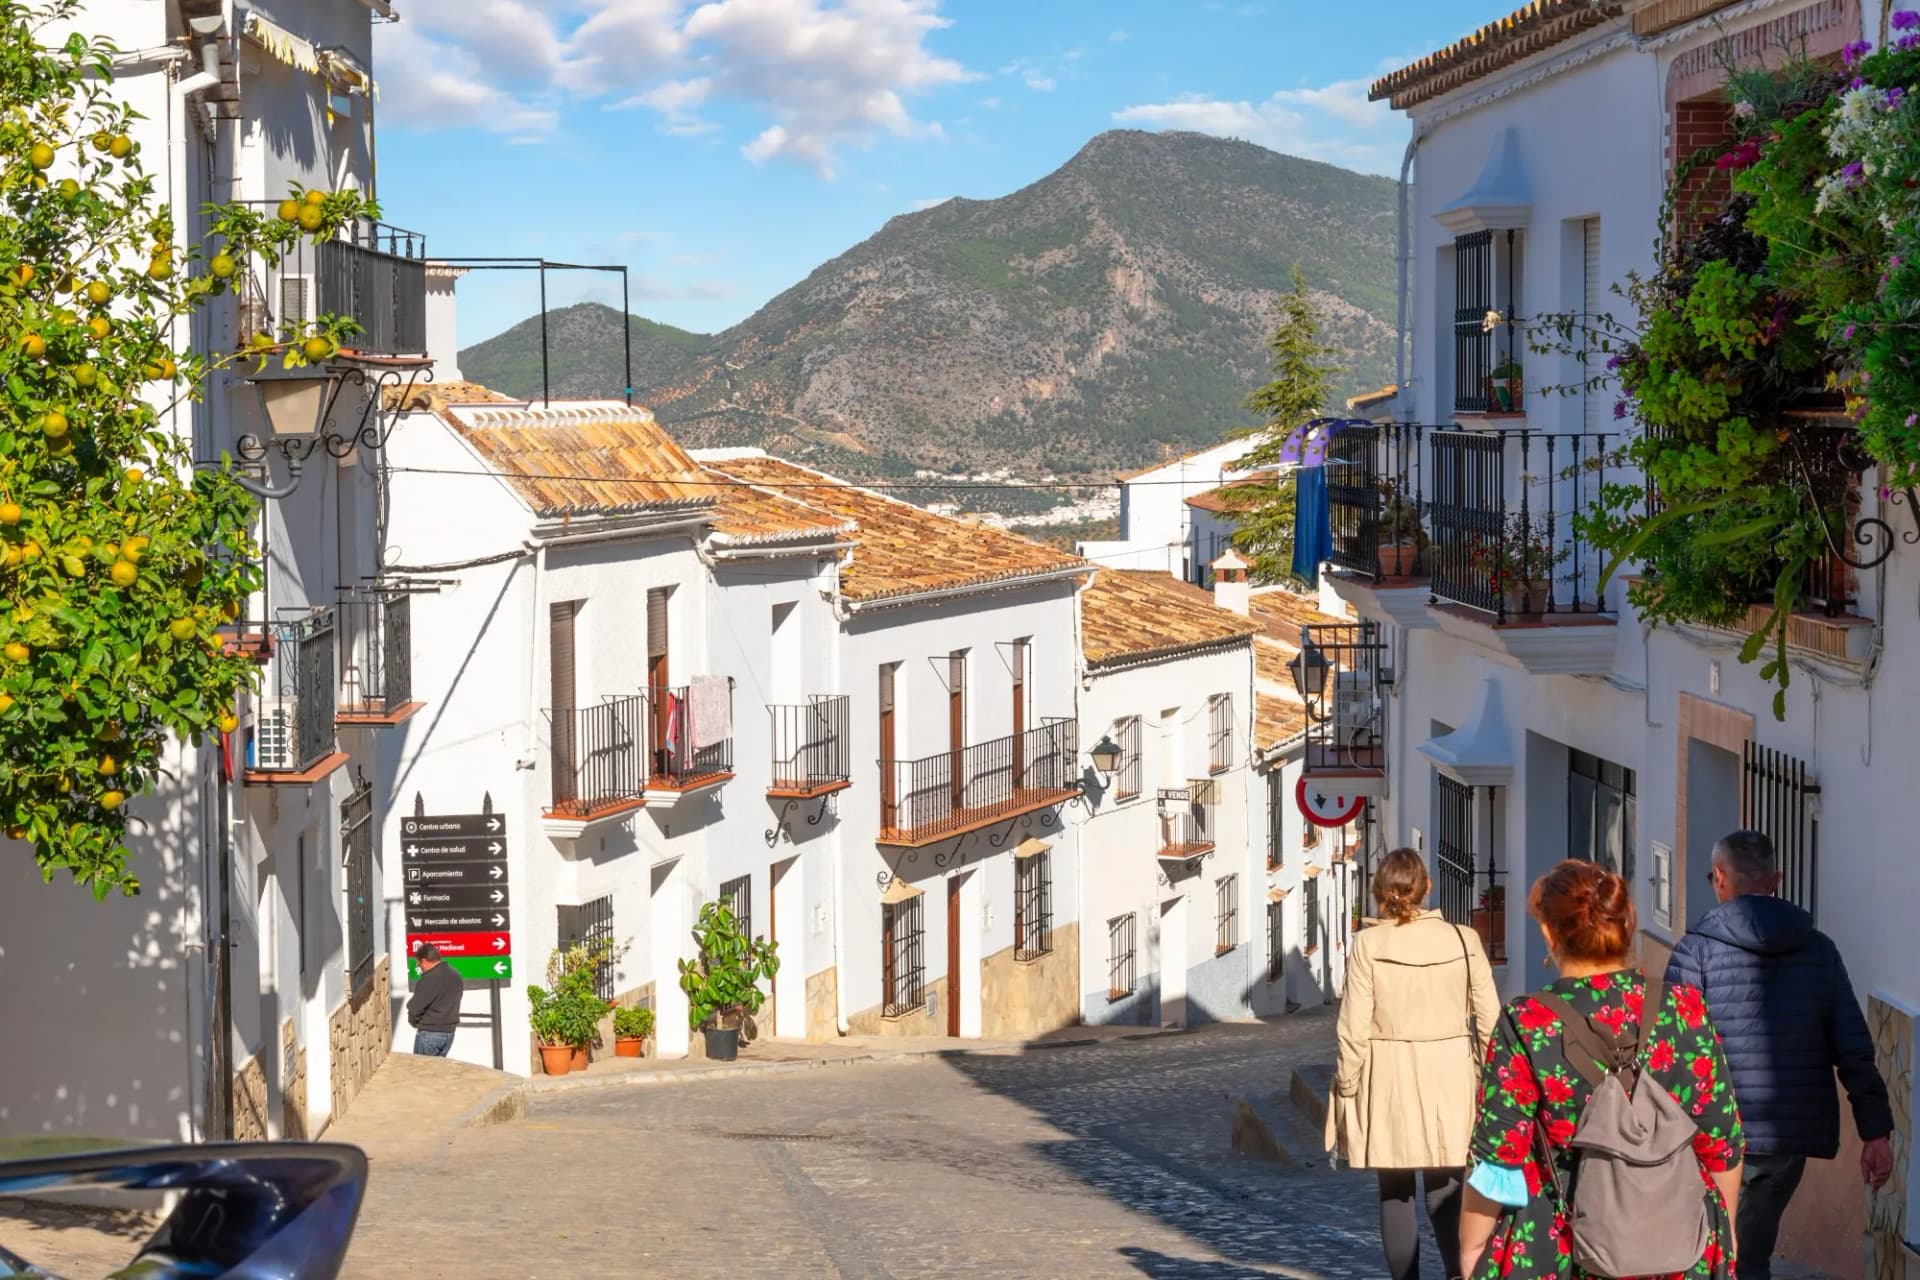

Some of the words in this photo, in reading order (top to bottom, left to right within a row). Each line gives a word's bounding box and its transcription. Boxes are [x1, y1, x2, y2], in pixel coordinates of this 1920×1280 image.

[1168, 791, 1189, 799] VENDE
[419, 823, 439, 831] Centro
[439, 822, 461, 830] urbano
[449, 845, 466, 853] salud
[422, 870, 463, 879] Aparcamiento
[423, 894, 450, 902] Farmacia
[458, 917, 482, 925] abastos
